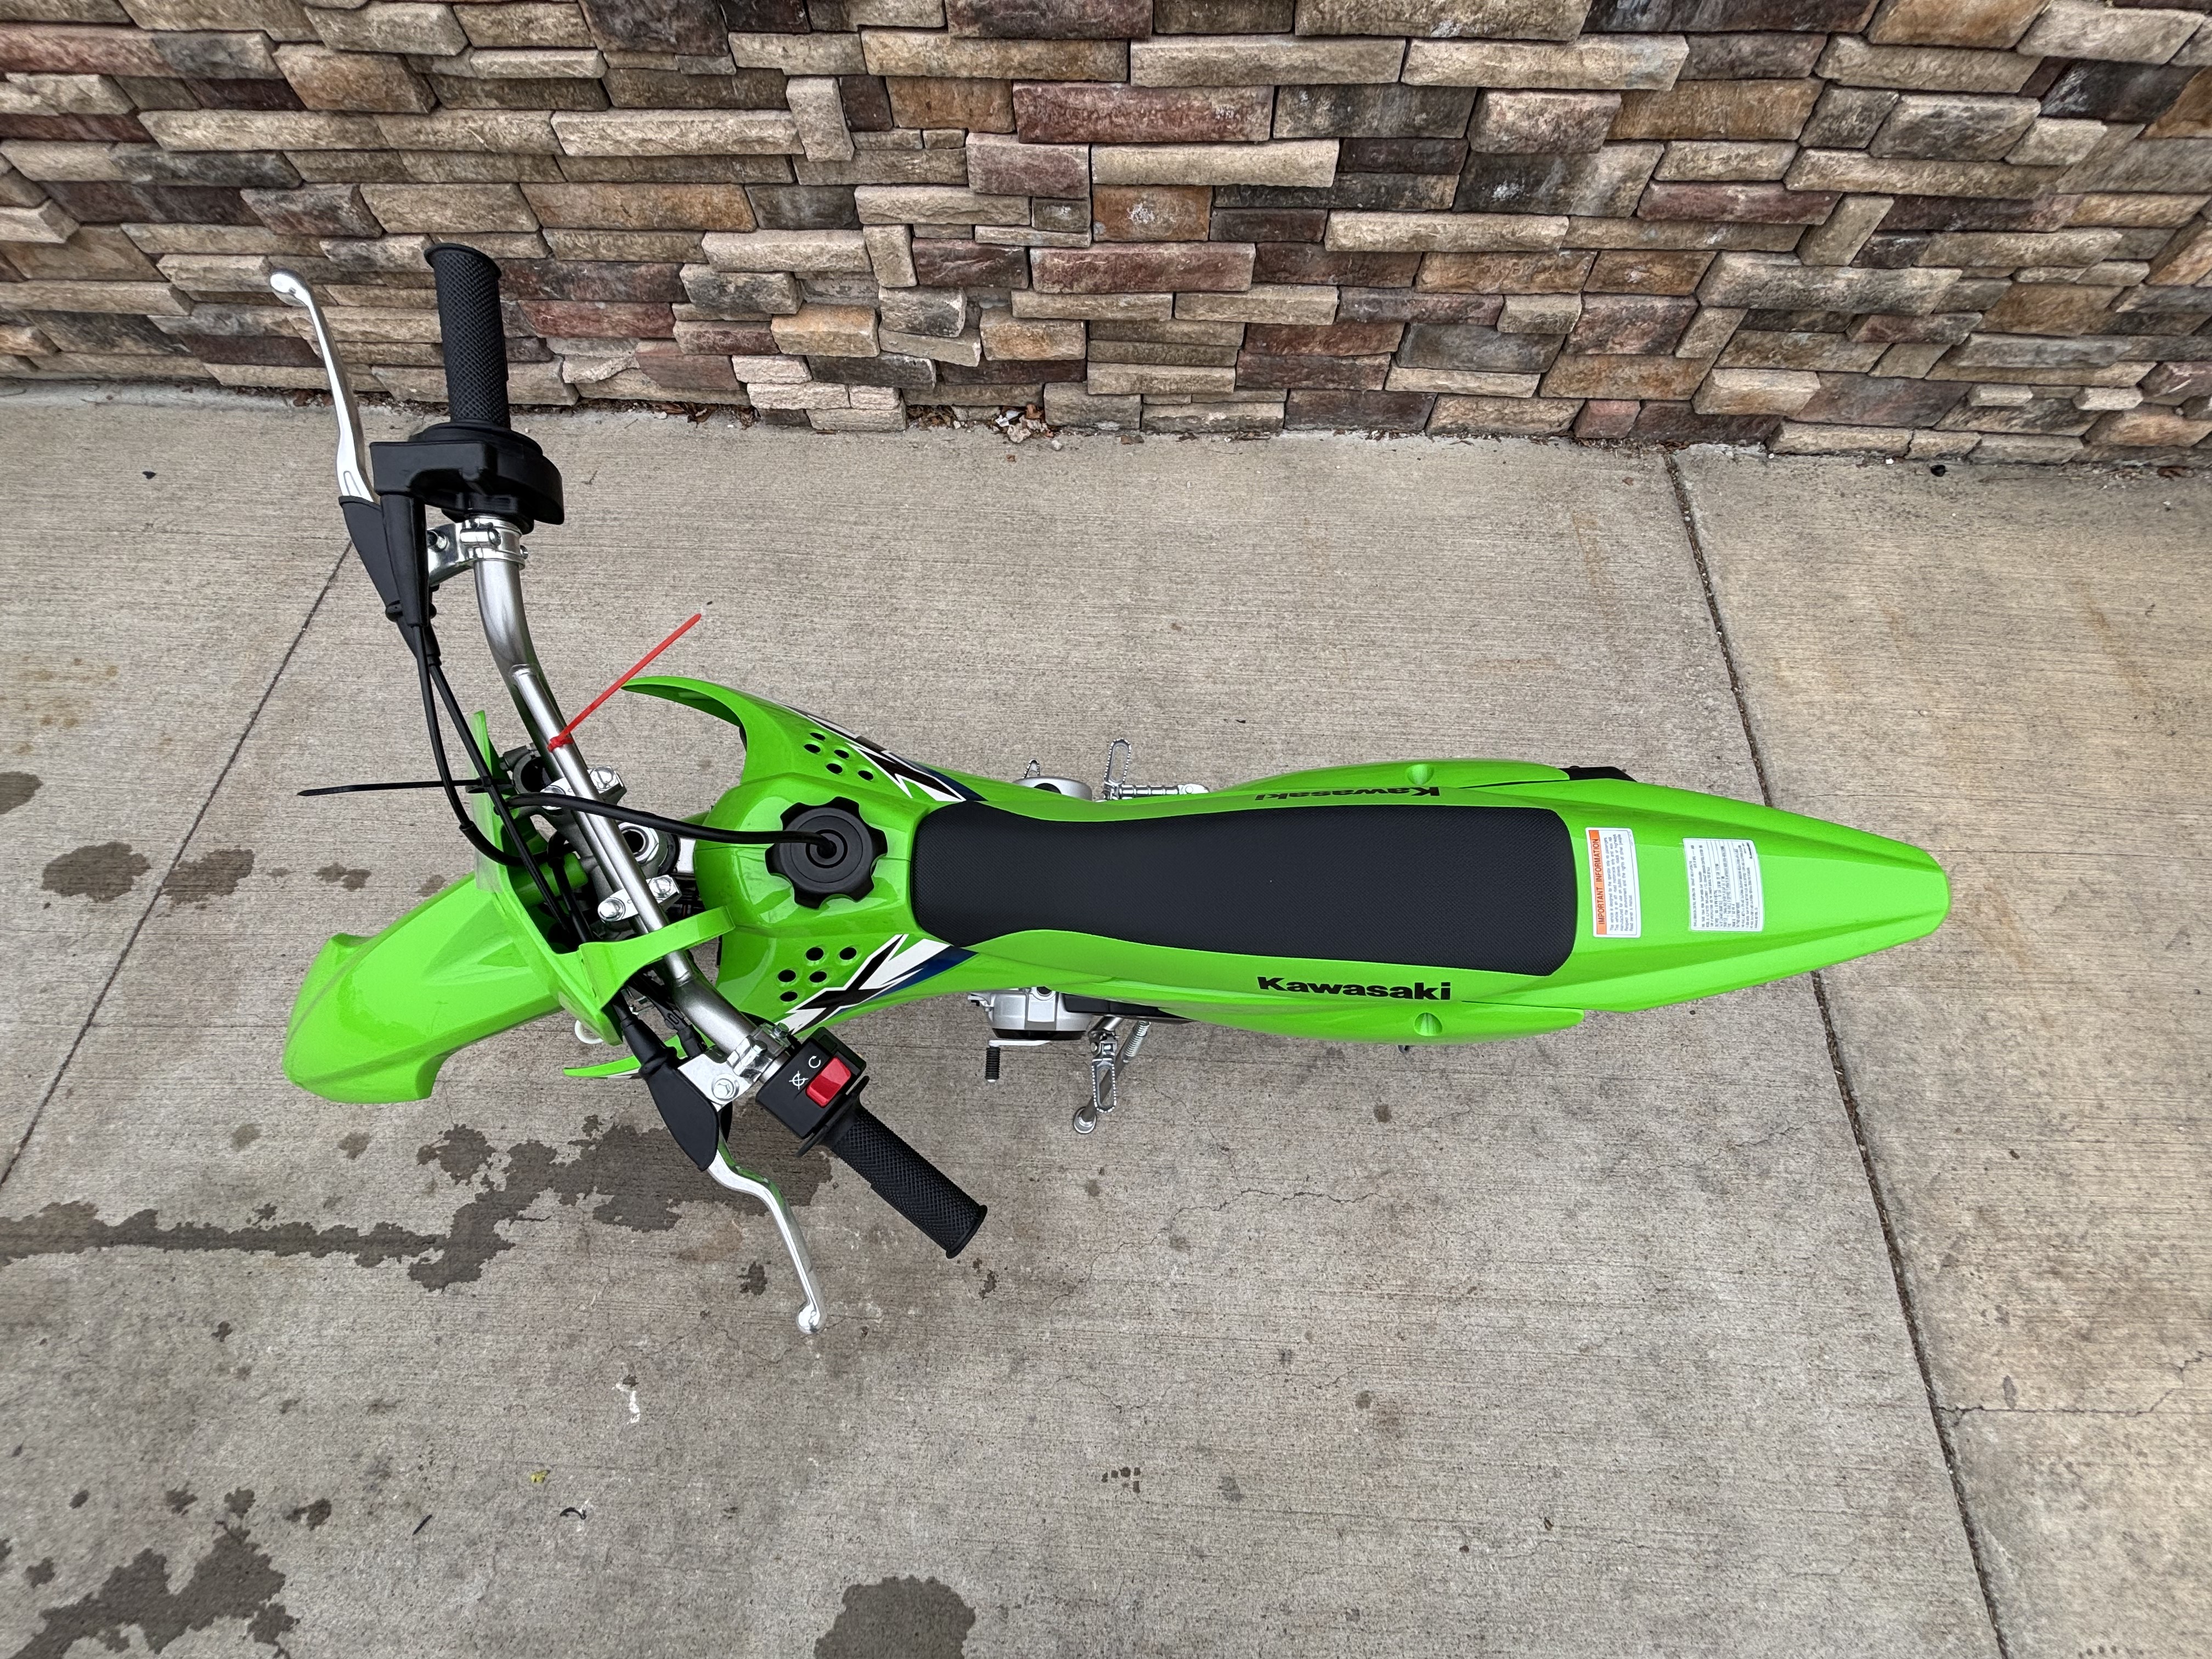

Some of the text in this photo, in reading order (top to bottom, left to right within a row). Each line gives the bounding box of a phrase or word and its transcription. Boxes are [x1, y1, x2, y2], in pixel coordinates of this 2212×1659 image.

[1255, 787, 1440, 800] Kawasaki
[1592, 839, 1605, 924] IMPORTANT INFORMATION
[1257, 977, 1451, 1000] Kawasaki
